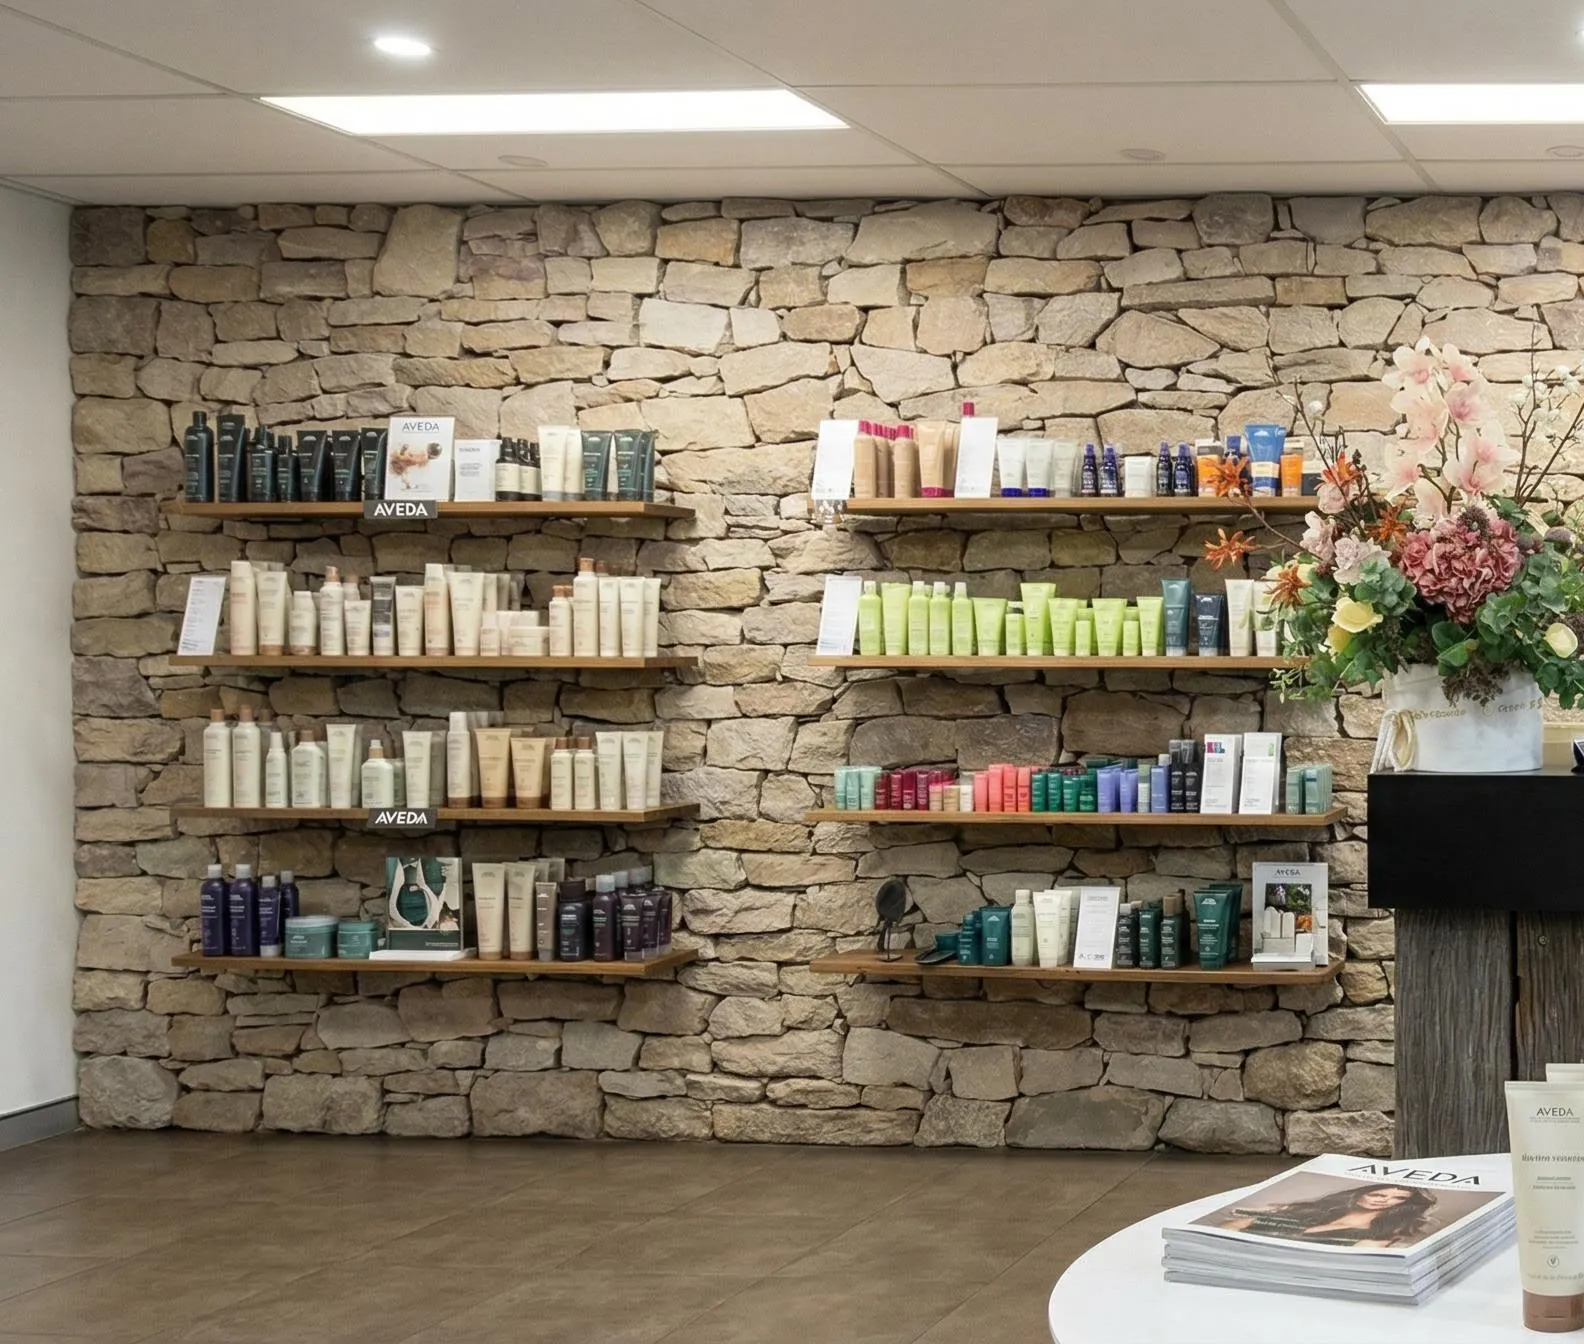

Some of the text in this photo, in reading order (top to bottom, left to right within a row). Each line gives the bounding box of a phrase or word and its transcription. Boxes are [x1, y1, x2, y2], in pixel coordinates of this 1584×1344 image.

[402, 422, 440, 431] AVEDA
[374, 503, 428, 516] AVEDA
[375, 811, 428, 824] AVEDA
[1536, 1107, 1574, 1116] AVEDA
[1348, 1164, 1480, 1186] AVEDA
